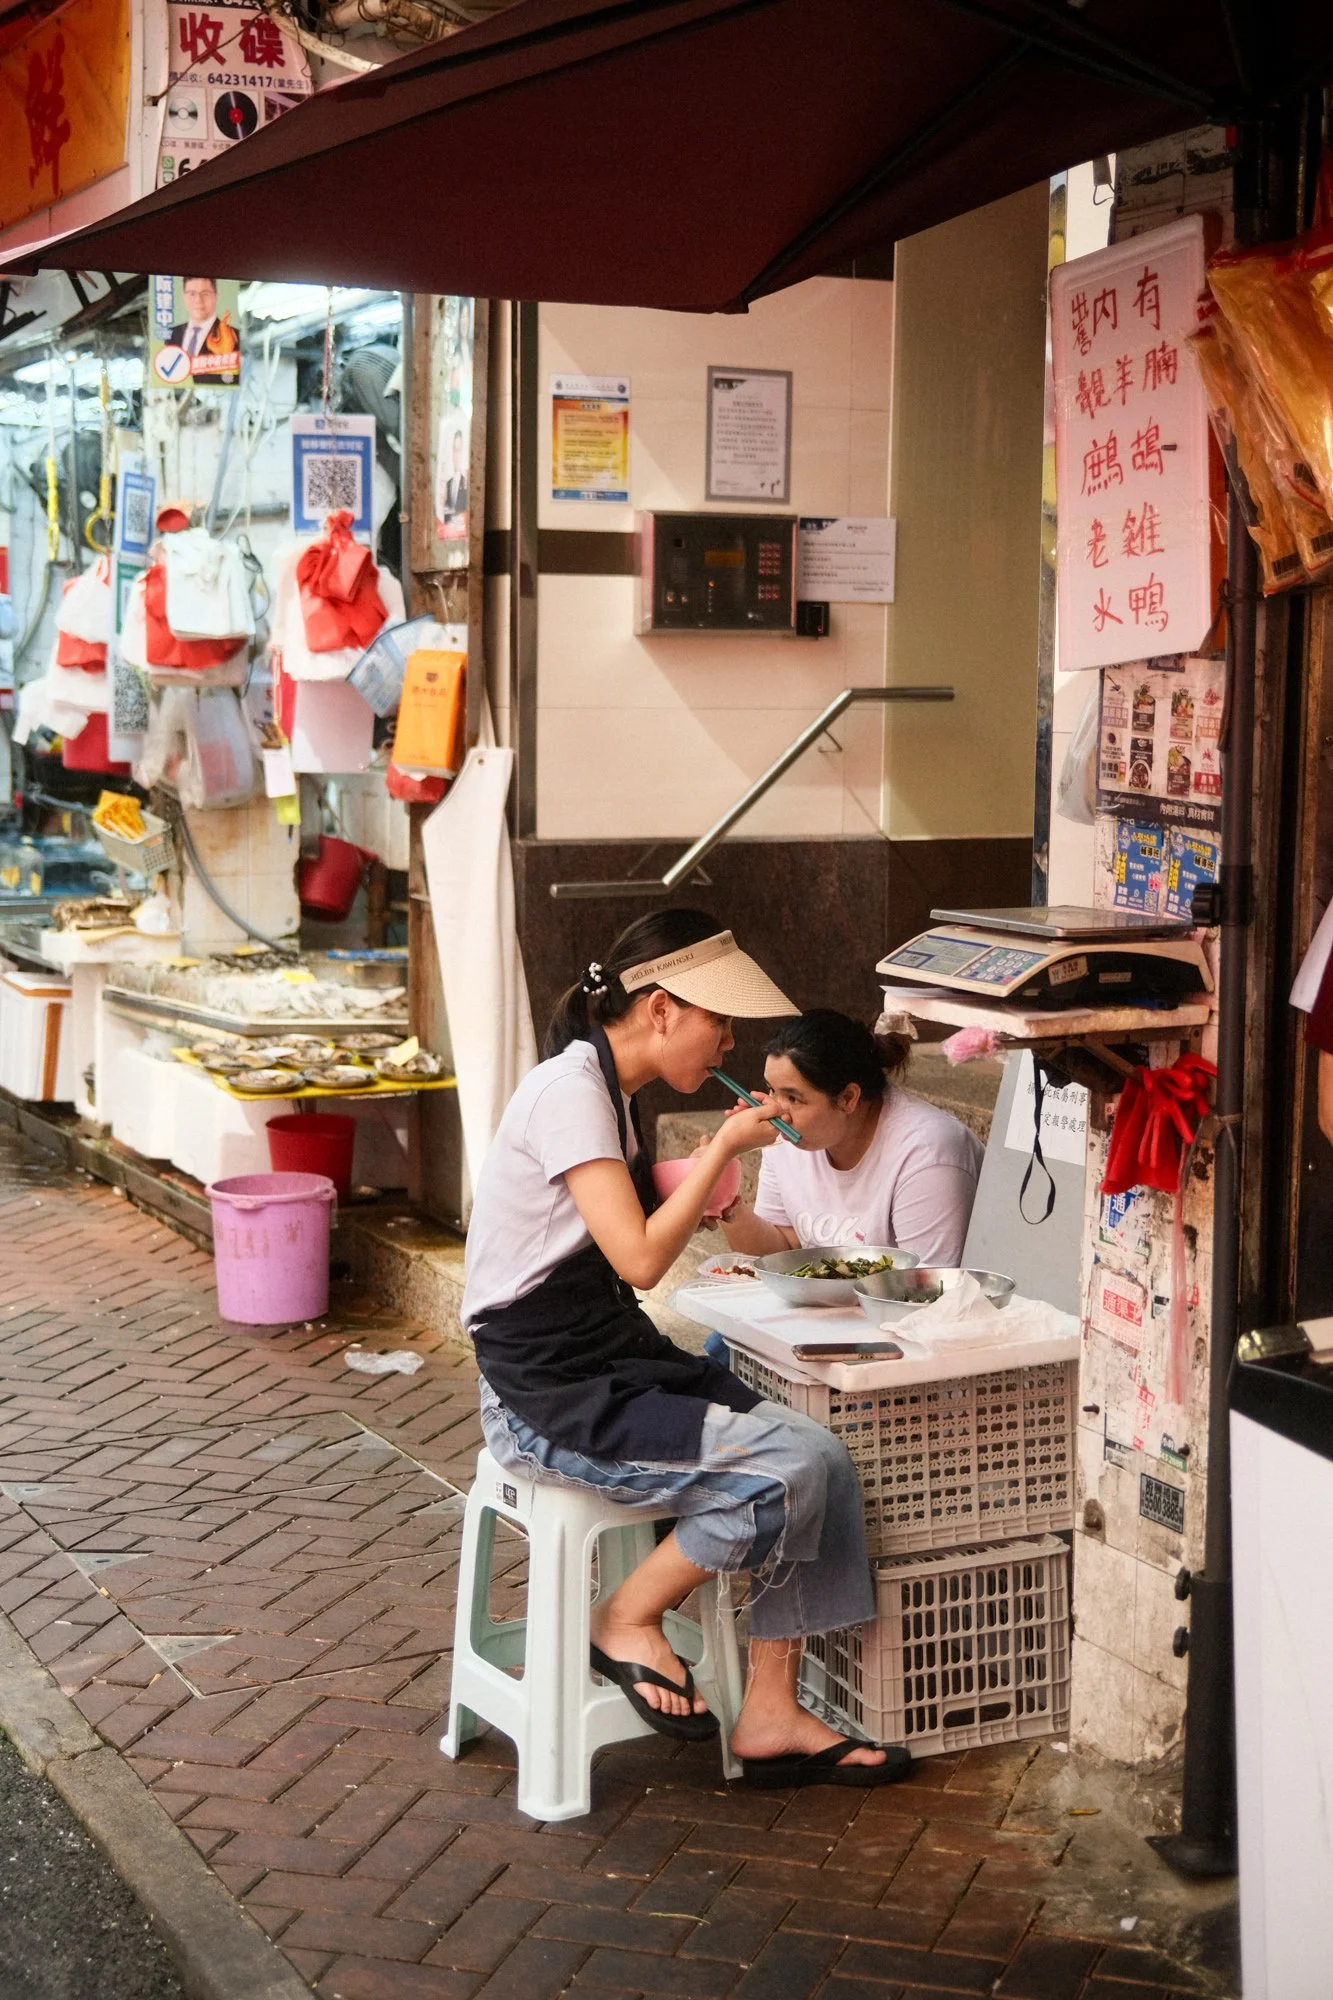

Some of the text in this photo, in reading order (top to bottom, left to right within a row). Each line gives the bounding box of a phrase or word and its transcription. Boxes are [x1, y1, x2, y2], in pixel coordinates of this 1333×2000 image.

[179, 12, 286, 68] 收碟
[207, 72, 273, 87] 64231417
[1093, 572, 1170, 633] 水鴨
[656, 952, 695, 972] KAWINSKI
[1103, 1289, 1141, 1325] 通渠王
